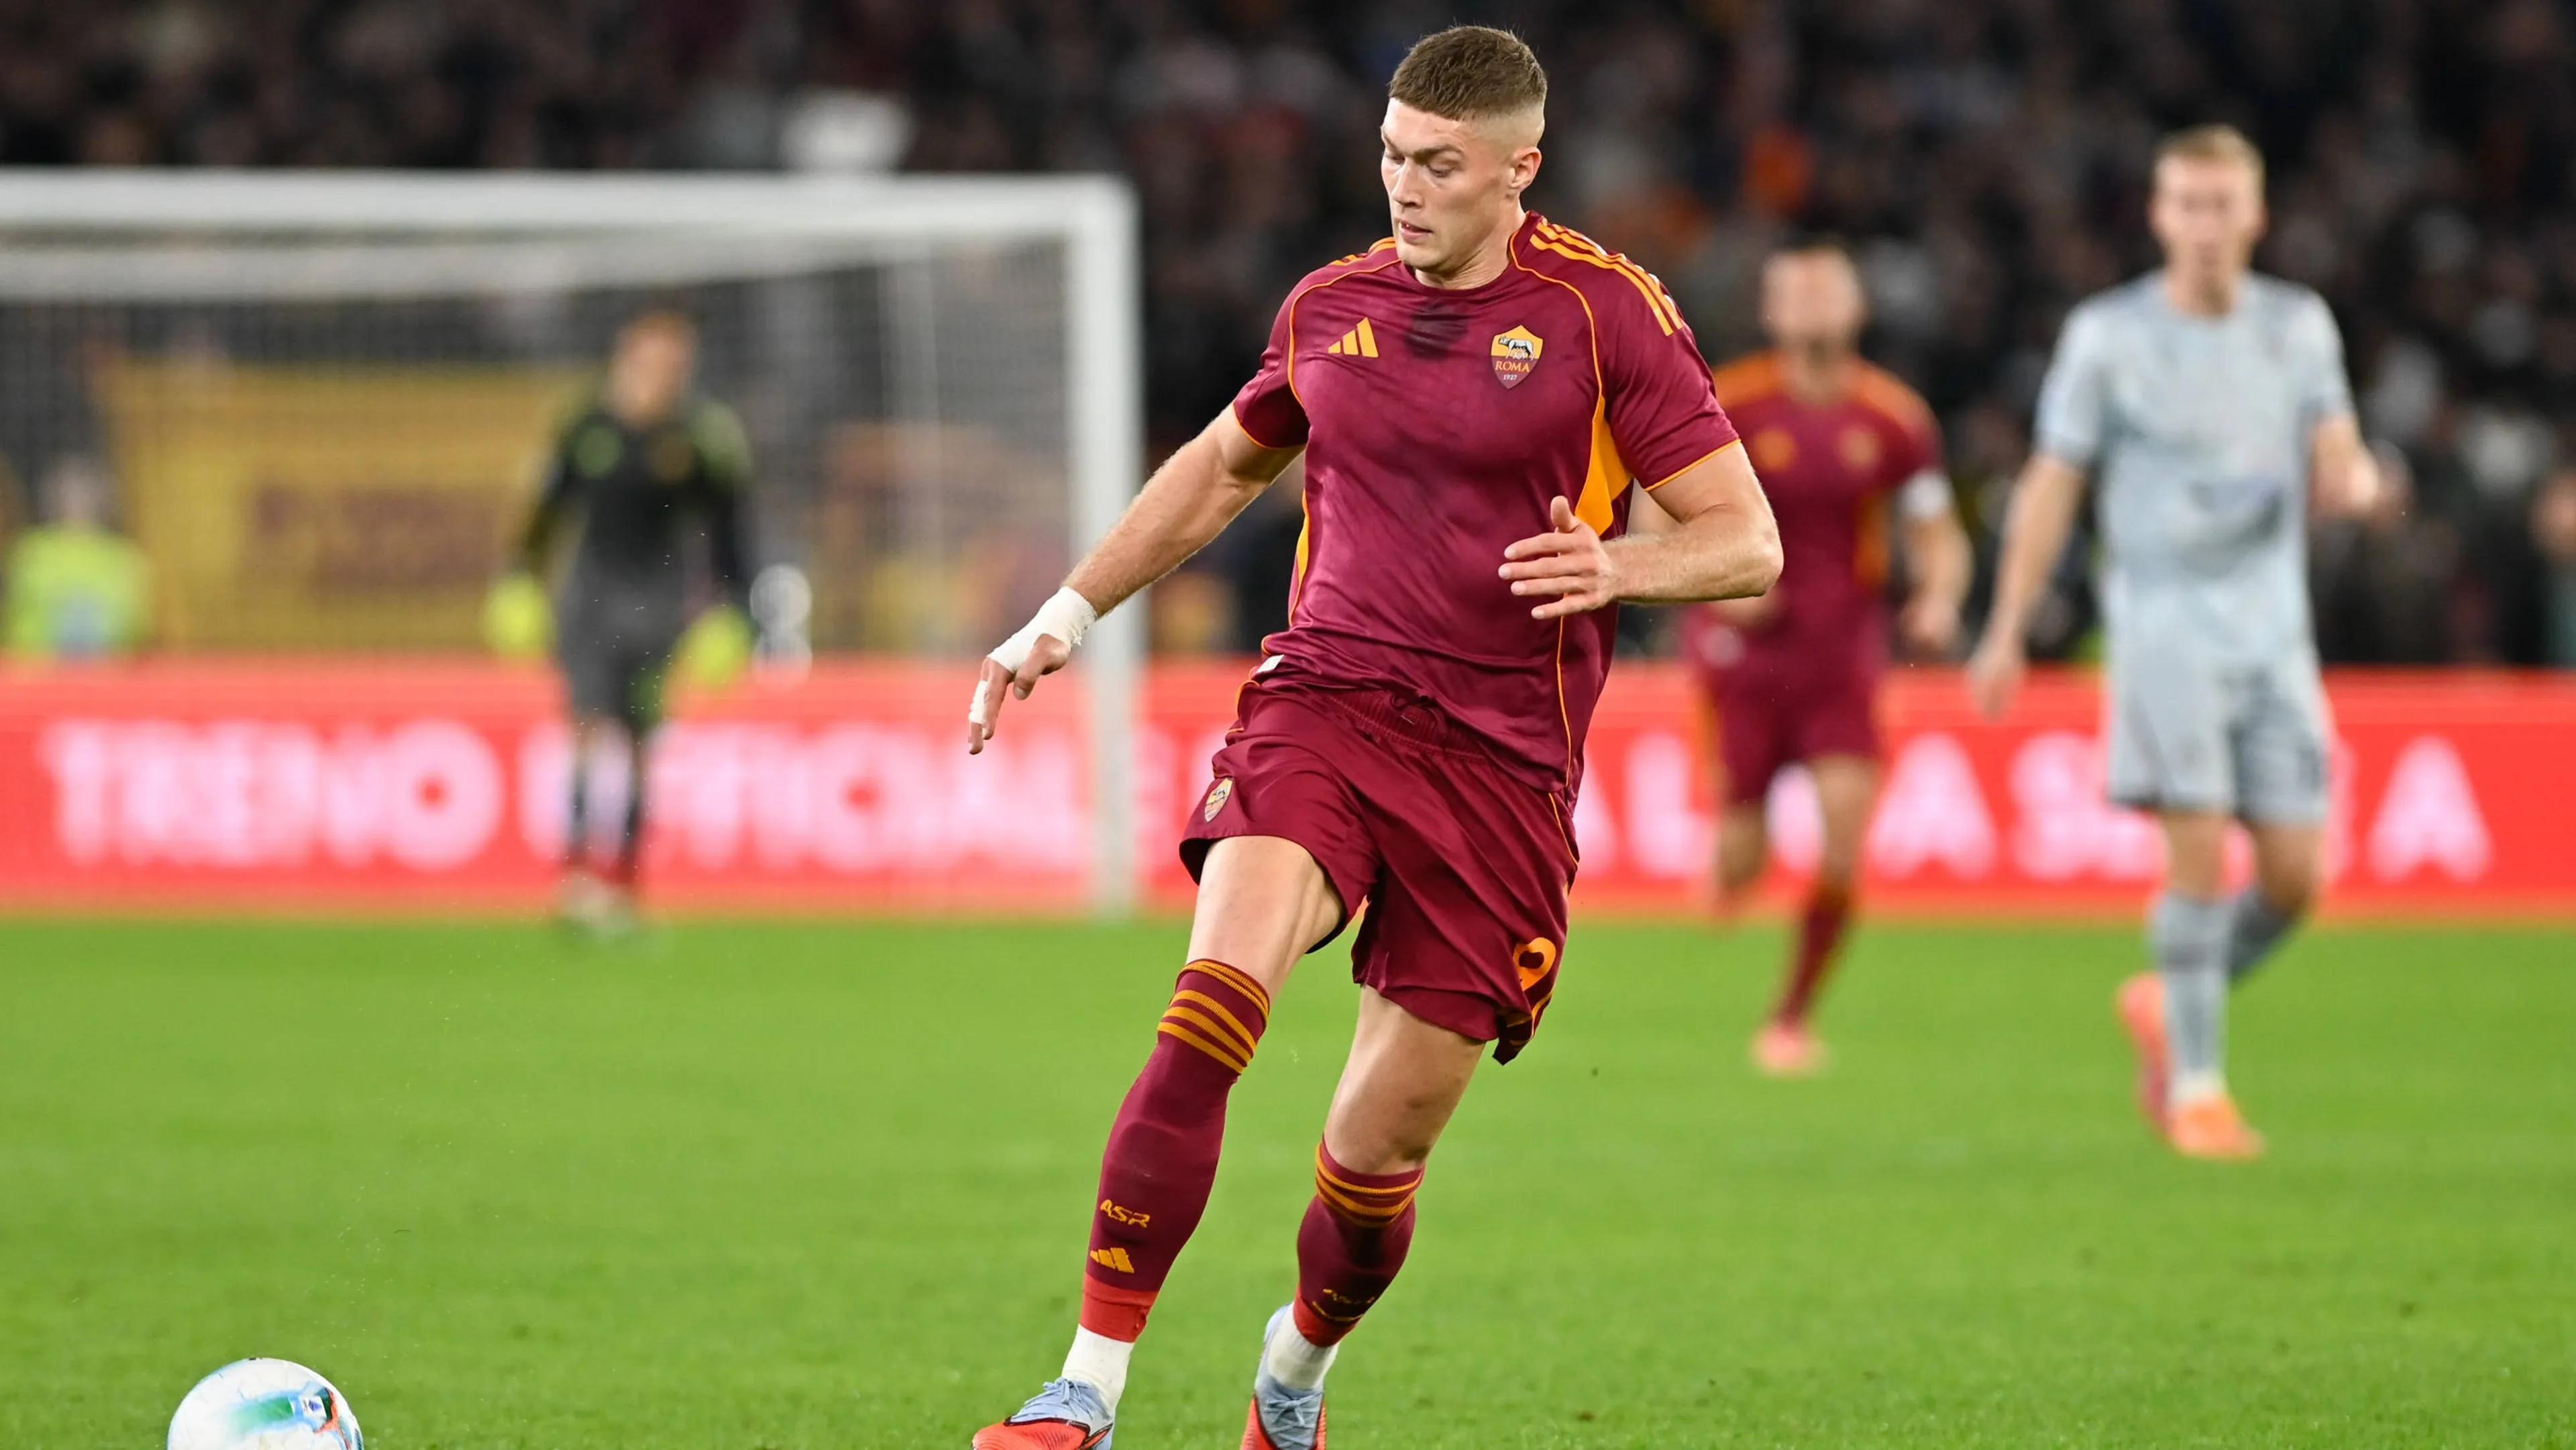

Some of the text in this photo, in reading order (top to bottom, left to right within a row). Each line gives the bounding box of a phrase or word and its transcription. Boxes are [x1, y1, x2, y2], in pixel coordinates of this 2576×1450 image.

[1495, 360, 1530, 372] ROMA
[44, 723, 503, 868] TRENO
[1100, 1199, 1150, 1228] ASR
